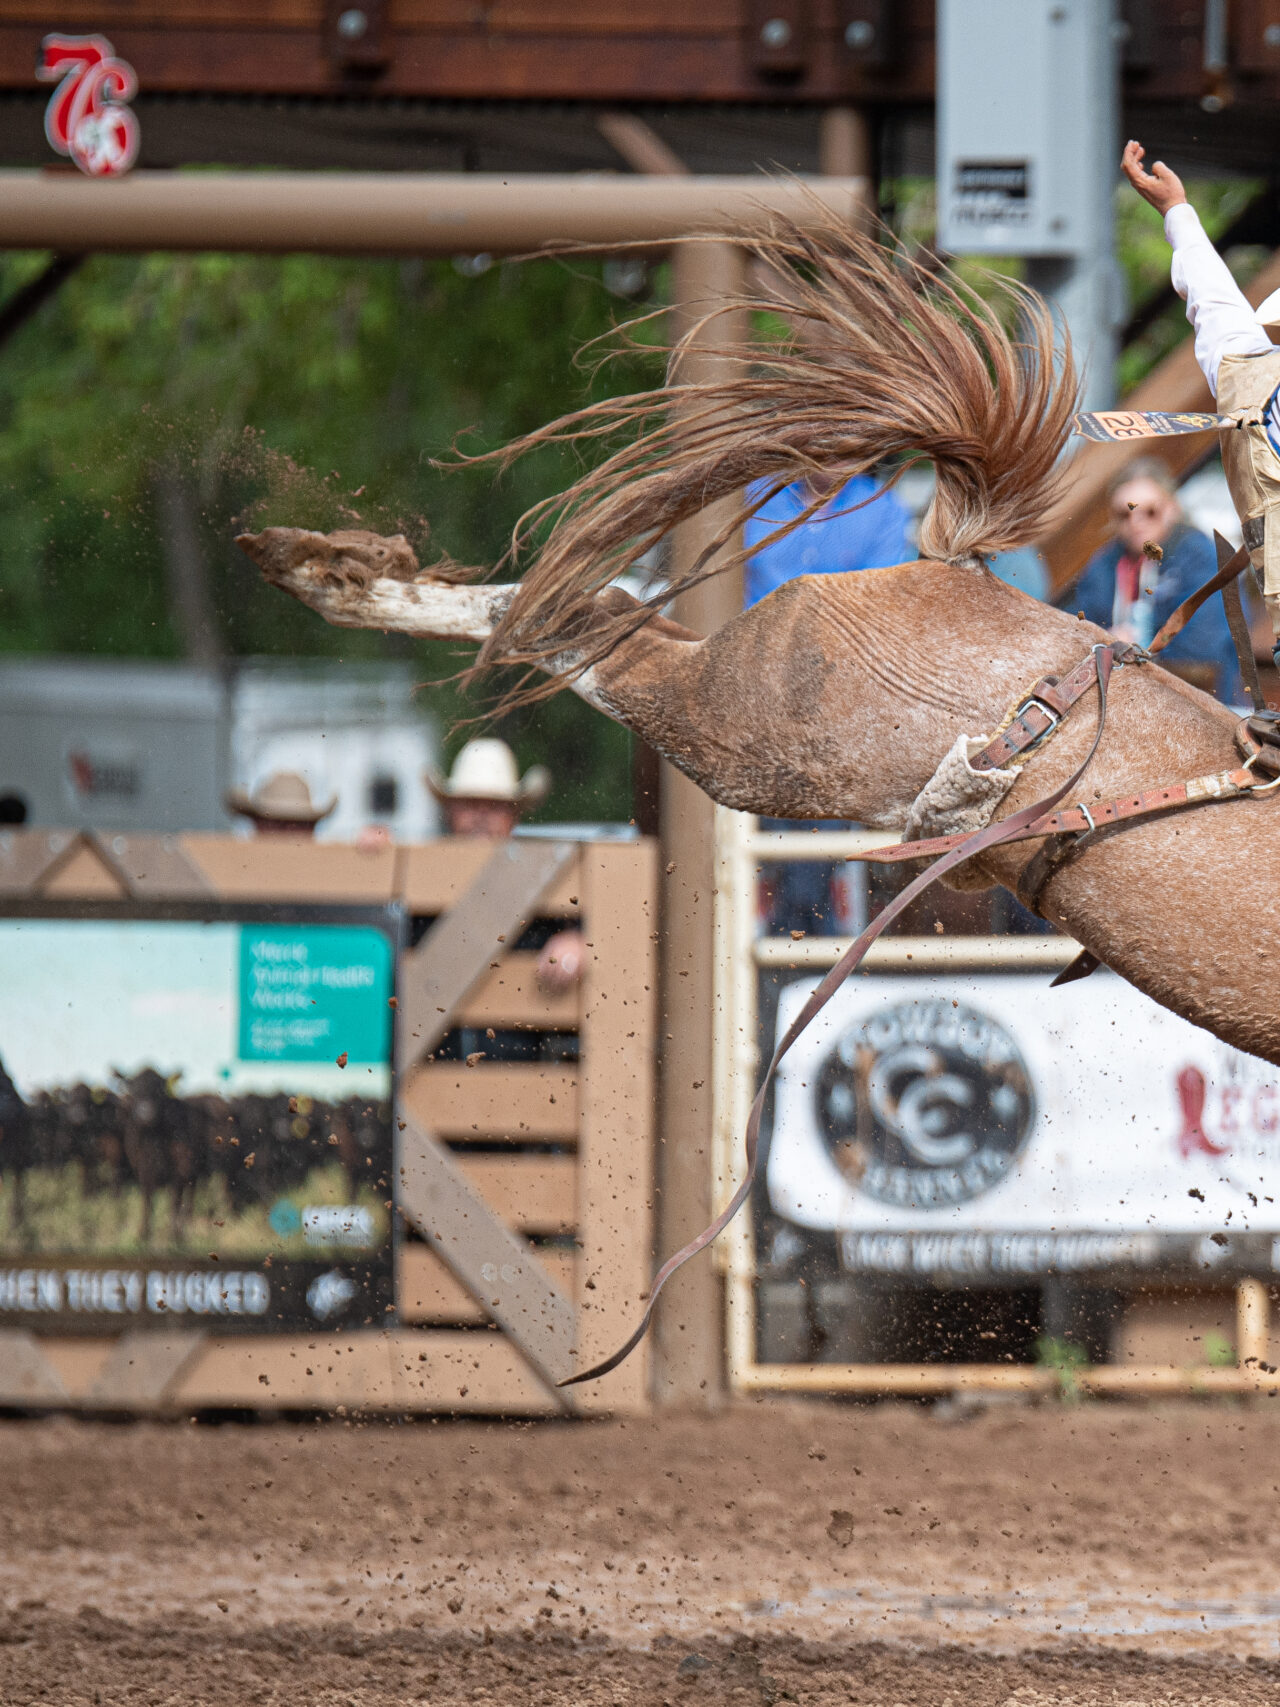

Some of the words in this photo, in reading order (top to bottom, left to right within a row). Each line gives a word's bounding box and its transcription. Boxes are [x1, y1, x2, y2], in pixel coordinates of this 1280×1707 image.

[35, 32, 141, 177] 76
[66, 1268, 144, 1314] THEY
[146, 1269, 270, 1315] BUCKED
